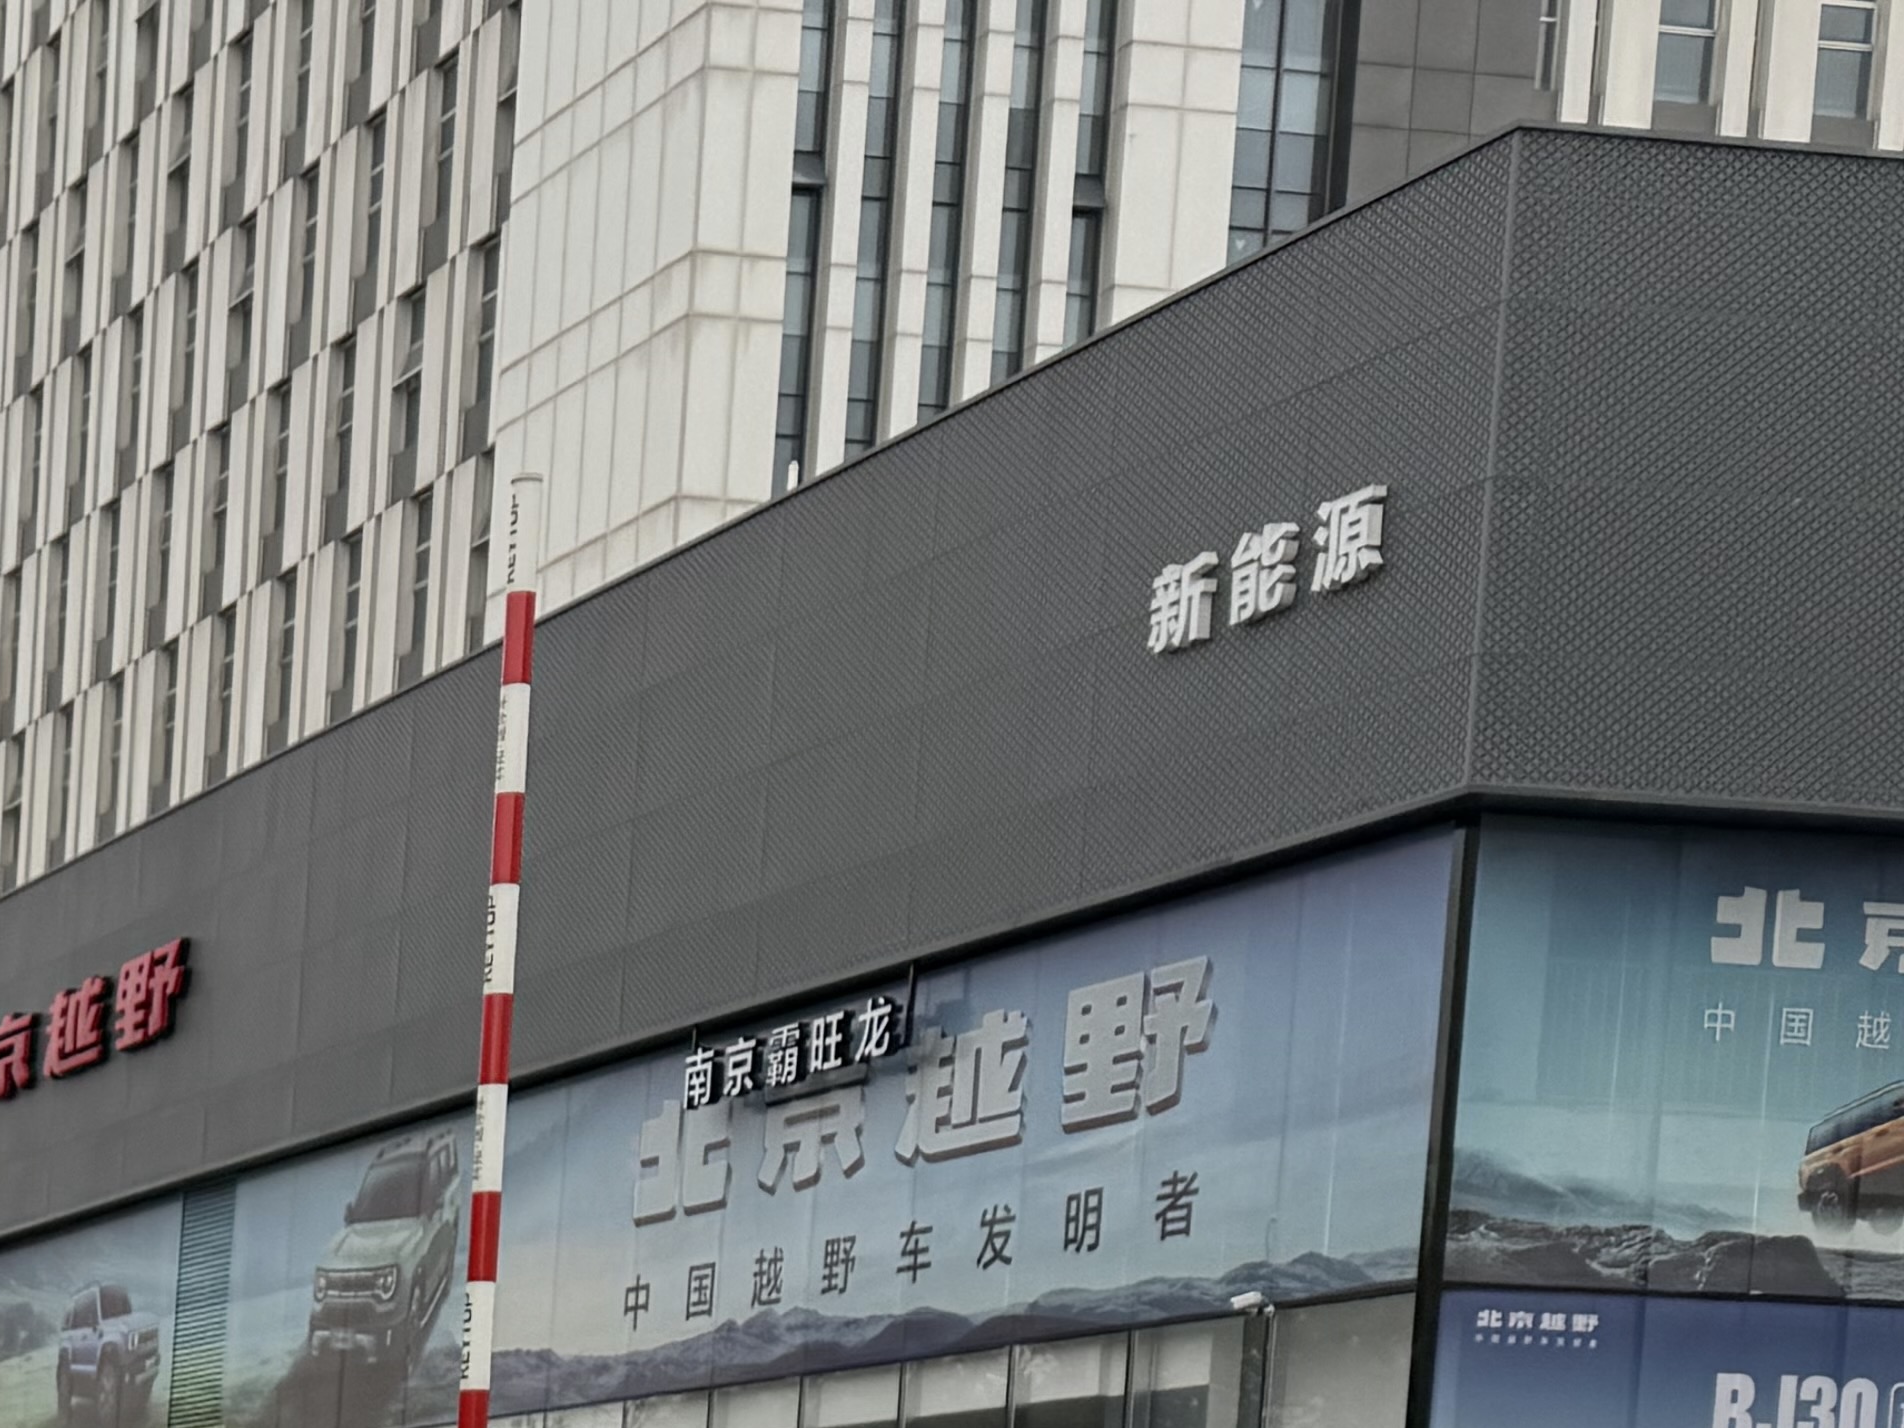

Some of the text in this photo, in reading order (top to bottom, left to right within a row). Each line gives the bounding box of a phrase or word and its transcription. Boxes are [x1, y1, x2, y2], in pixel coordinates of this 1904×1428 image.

[1146, 484, 1388, 654] 新能源
[633, 956, 1218, 1228] 北京越野
[683, 997, 893, 1110] 南京霸旺龙
[1704, 1002, 1892, 1049] 中国越
[623, 1170, 1200, 1331] 中国越野车发明者
